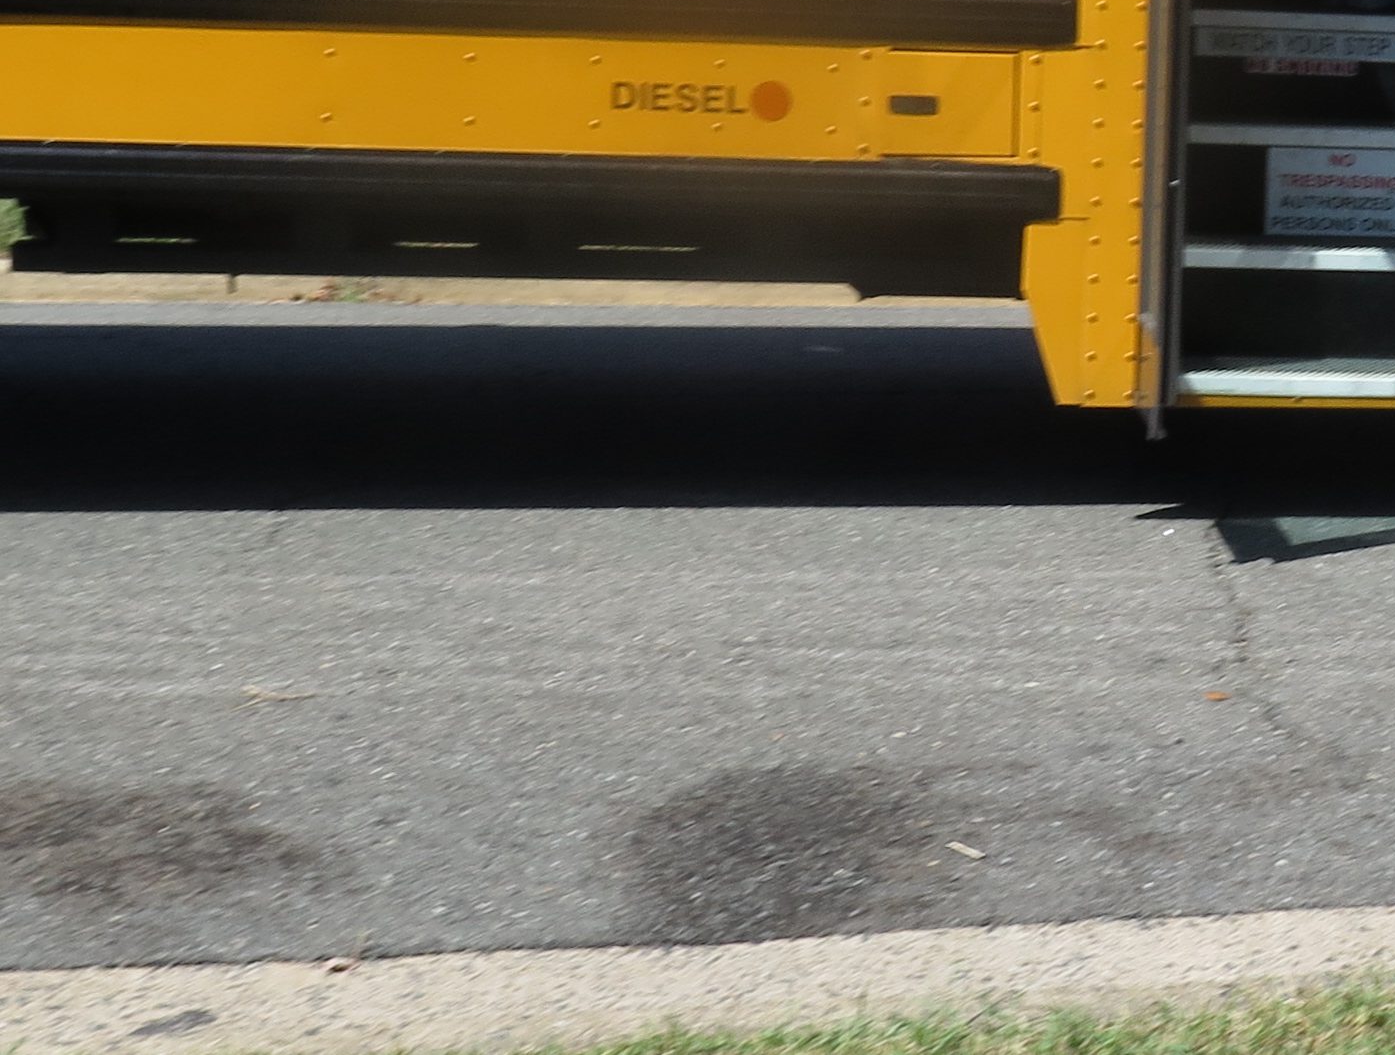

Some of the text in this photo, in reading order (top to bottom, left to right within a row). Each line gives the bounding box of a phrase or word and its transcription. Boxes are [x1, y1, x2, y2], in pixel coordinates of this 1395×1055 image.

[611, 80, 749, 114] DIESEL
[1327, 153, 1357, 168] NO
[1270, 215, 1356, 232] PERSONS
